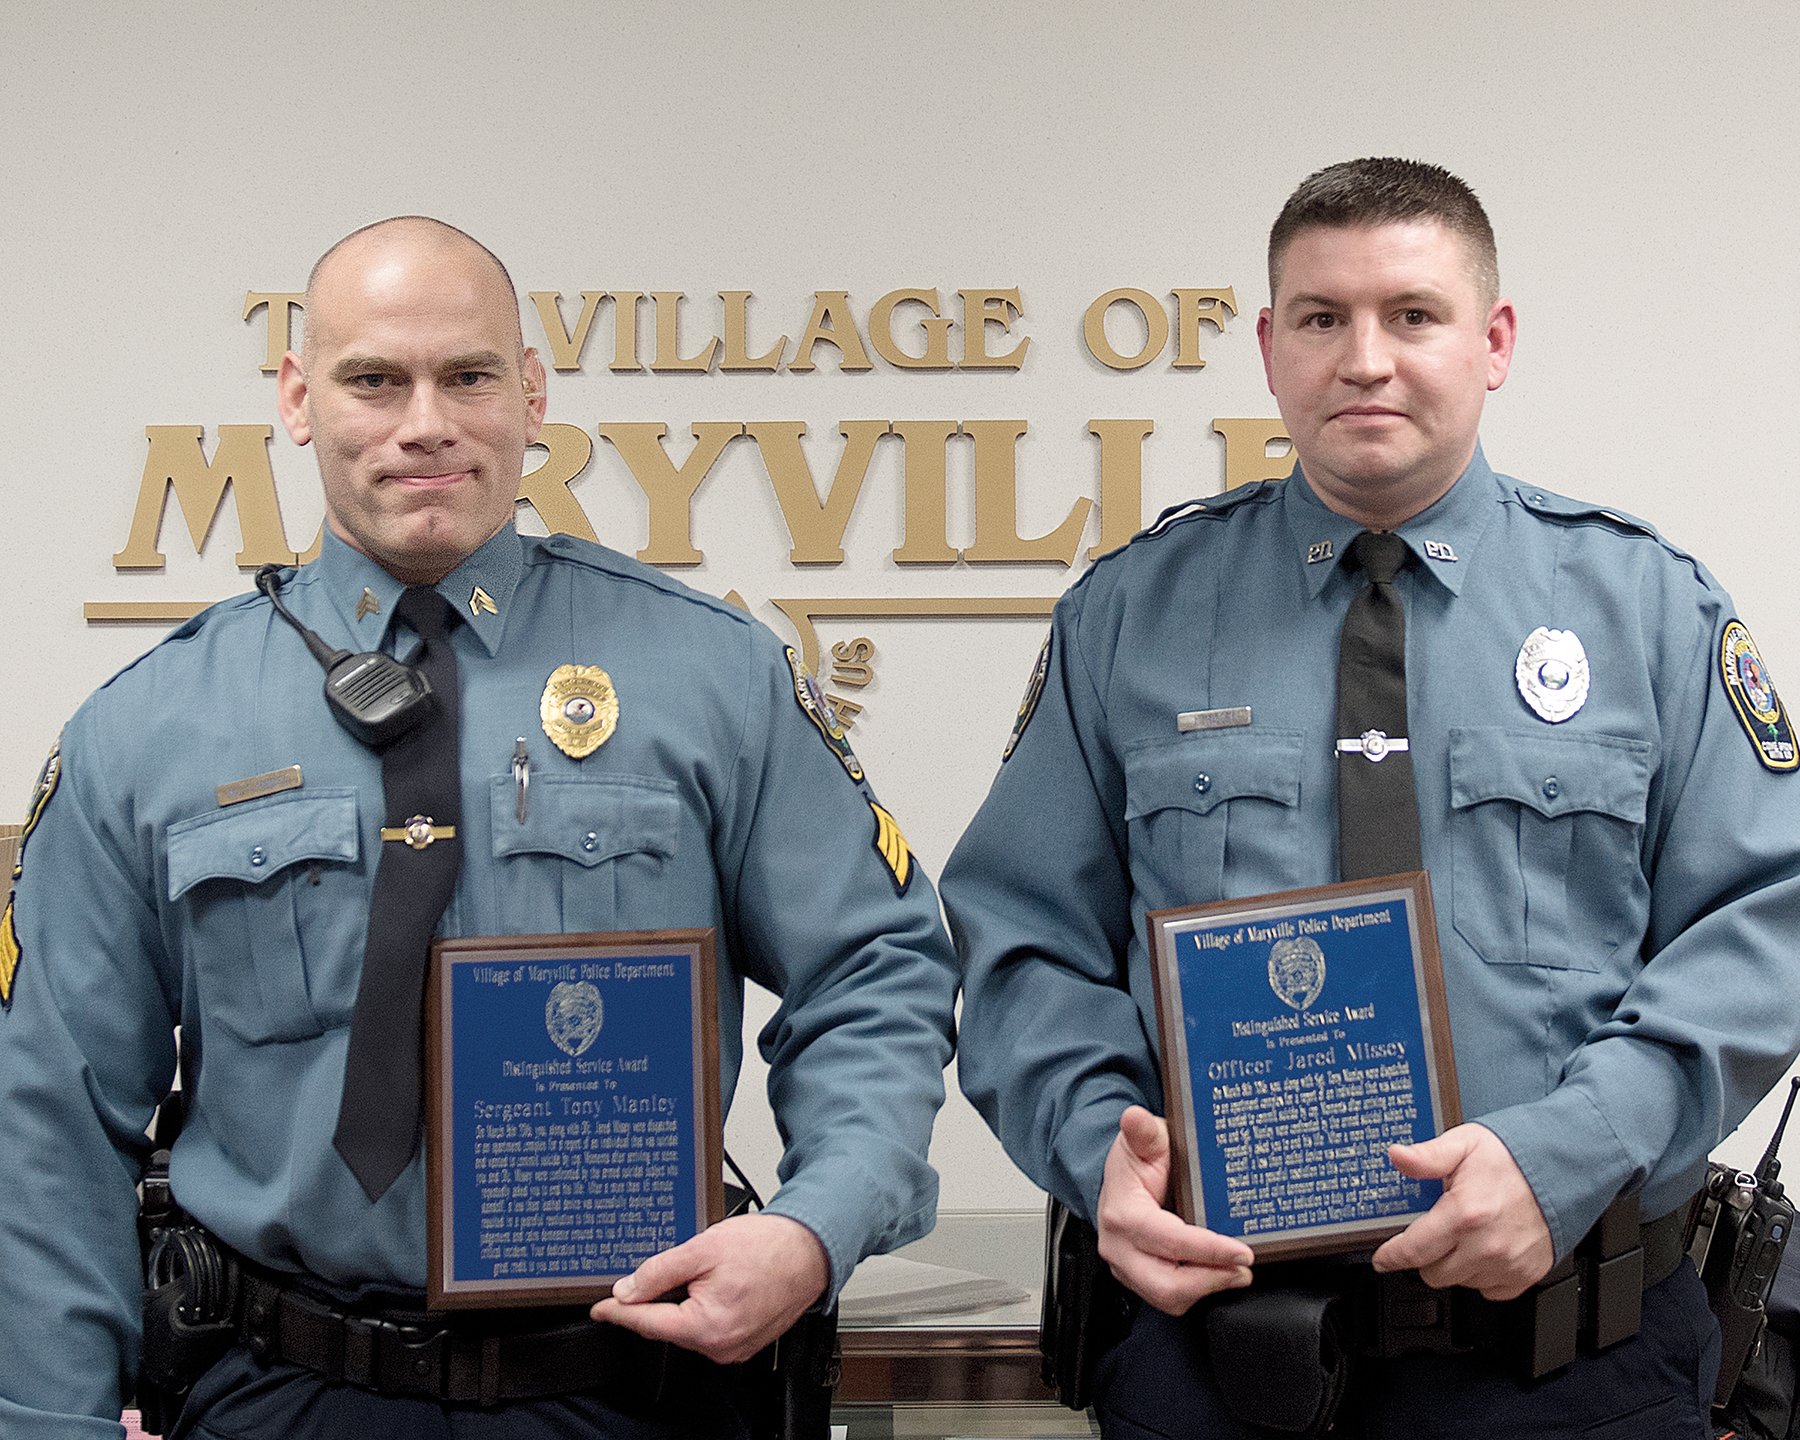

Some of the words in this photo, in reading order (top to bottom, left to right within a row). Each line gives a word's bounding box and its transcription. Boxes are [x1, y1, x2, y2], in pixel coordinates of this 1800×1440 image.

[529, 287, 1031, 372] VILLAGE
[1083, 286, 1239, 370] OF
[112, 418, 1299, 568] MRYVILL
[1194, 933, 1231, 950] Village
[1233, 929, 1243, 944] of
[1247, 922, 1298, 944] Maryville
[1298, 919, 1328, 935] Police
[1331, 909, 1391, 932] Department
[473, 968, 511, 987] Village
[514, 966, 525, 982] of
[528, 964, 578, 984] Maryville
[581, 964, 610, 979] Police
[615, 964, 675, 982] Department
[1232, 1013, 1300, 1037] Distinguished
[1303, 1010, 1340, 1026] Service
[1345, 1003, 1374, 1021] Award
[1279, 1031, 1328, 1047] Presented
[503, 1059, 571, 1080] Distinguished
[576, 1058, 612, 1074] Service
[619, 1056, 648, 1072] Award
[1209, 1060, 1273, 1080] Officer
[1287, 1046, 1336, 1070] Jared
[1347, 1042, 1405, 1061] Missey
[474, 1101, 552, 1122] Sergeant
[561, 1097, 602, 1118] Tony
[613, 1095, 676, 1116] Manley
